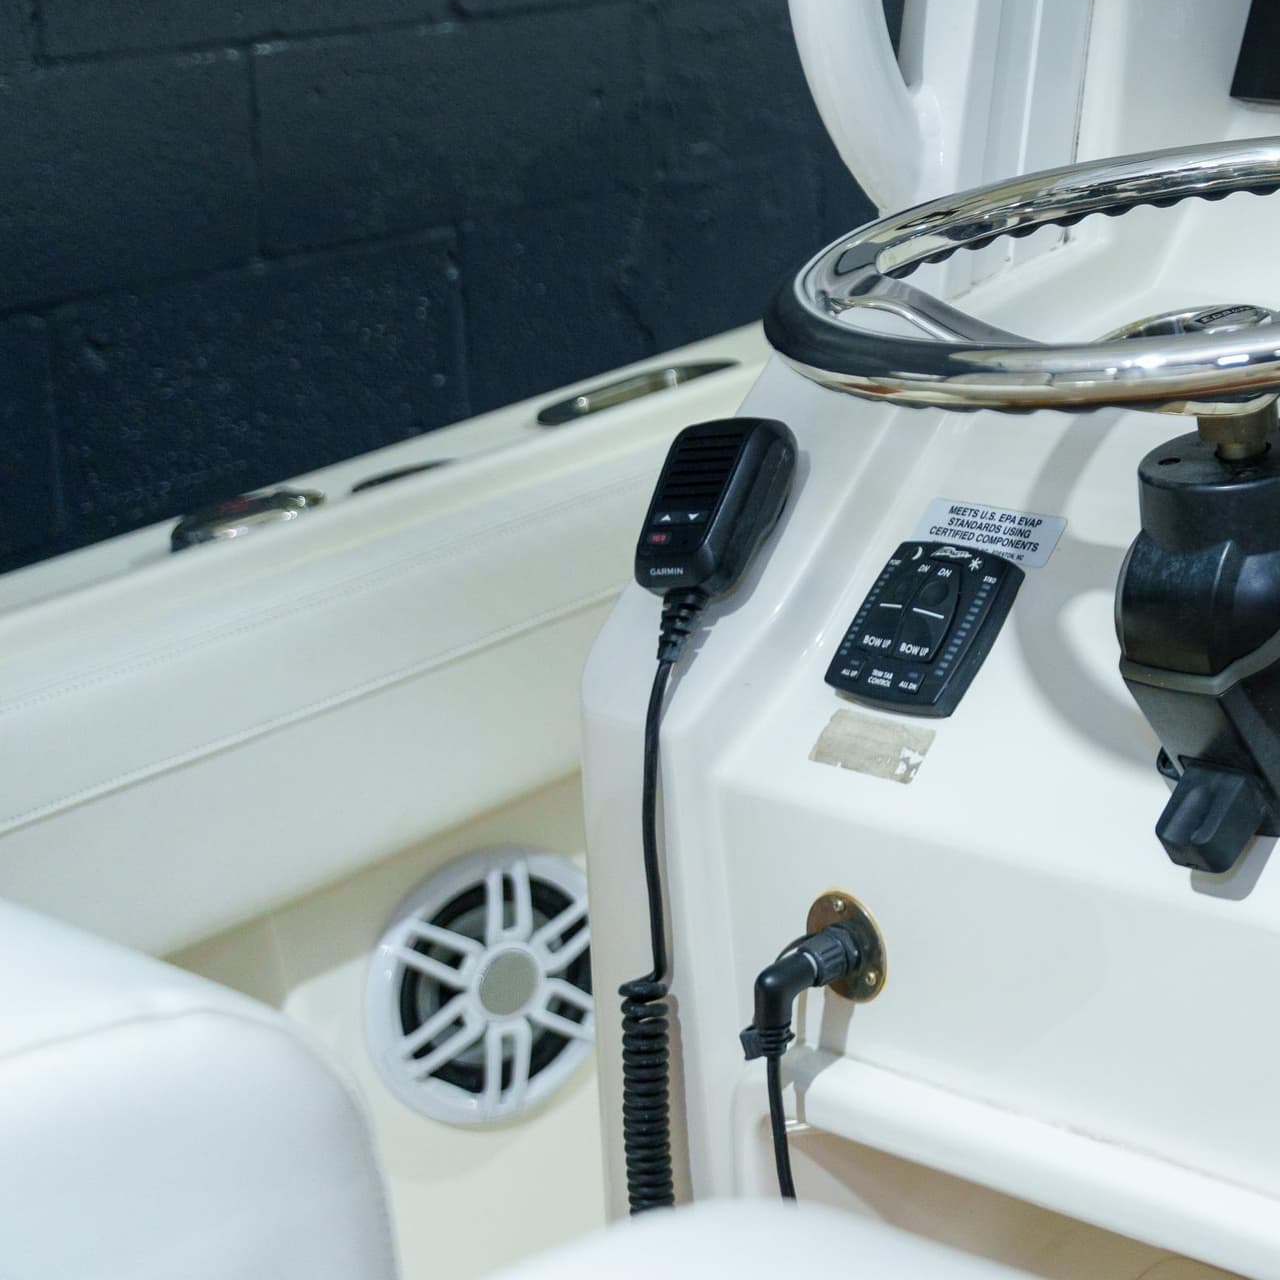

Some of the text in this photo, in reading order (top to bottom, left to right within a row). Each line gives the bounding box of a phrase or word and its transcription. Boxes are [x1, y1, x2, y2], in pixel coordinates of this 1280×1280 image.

[949, 506, 1042, 528] MEETS U.S. EPA EVAP
[948, 518, 1031, 538] STANDARDS USING
[930, 526, 975, 541] CERTIFIED
[976, 534, 1039, 552] COMPONENTS
[649, 567, 683, 575] GARMIN
[937, 568, 952, 578] DN
[863, 634, 891, 648] BOW UP
[900, 642, 929, 656] BOW UP
